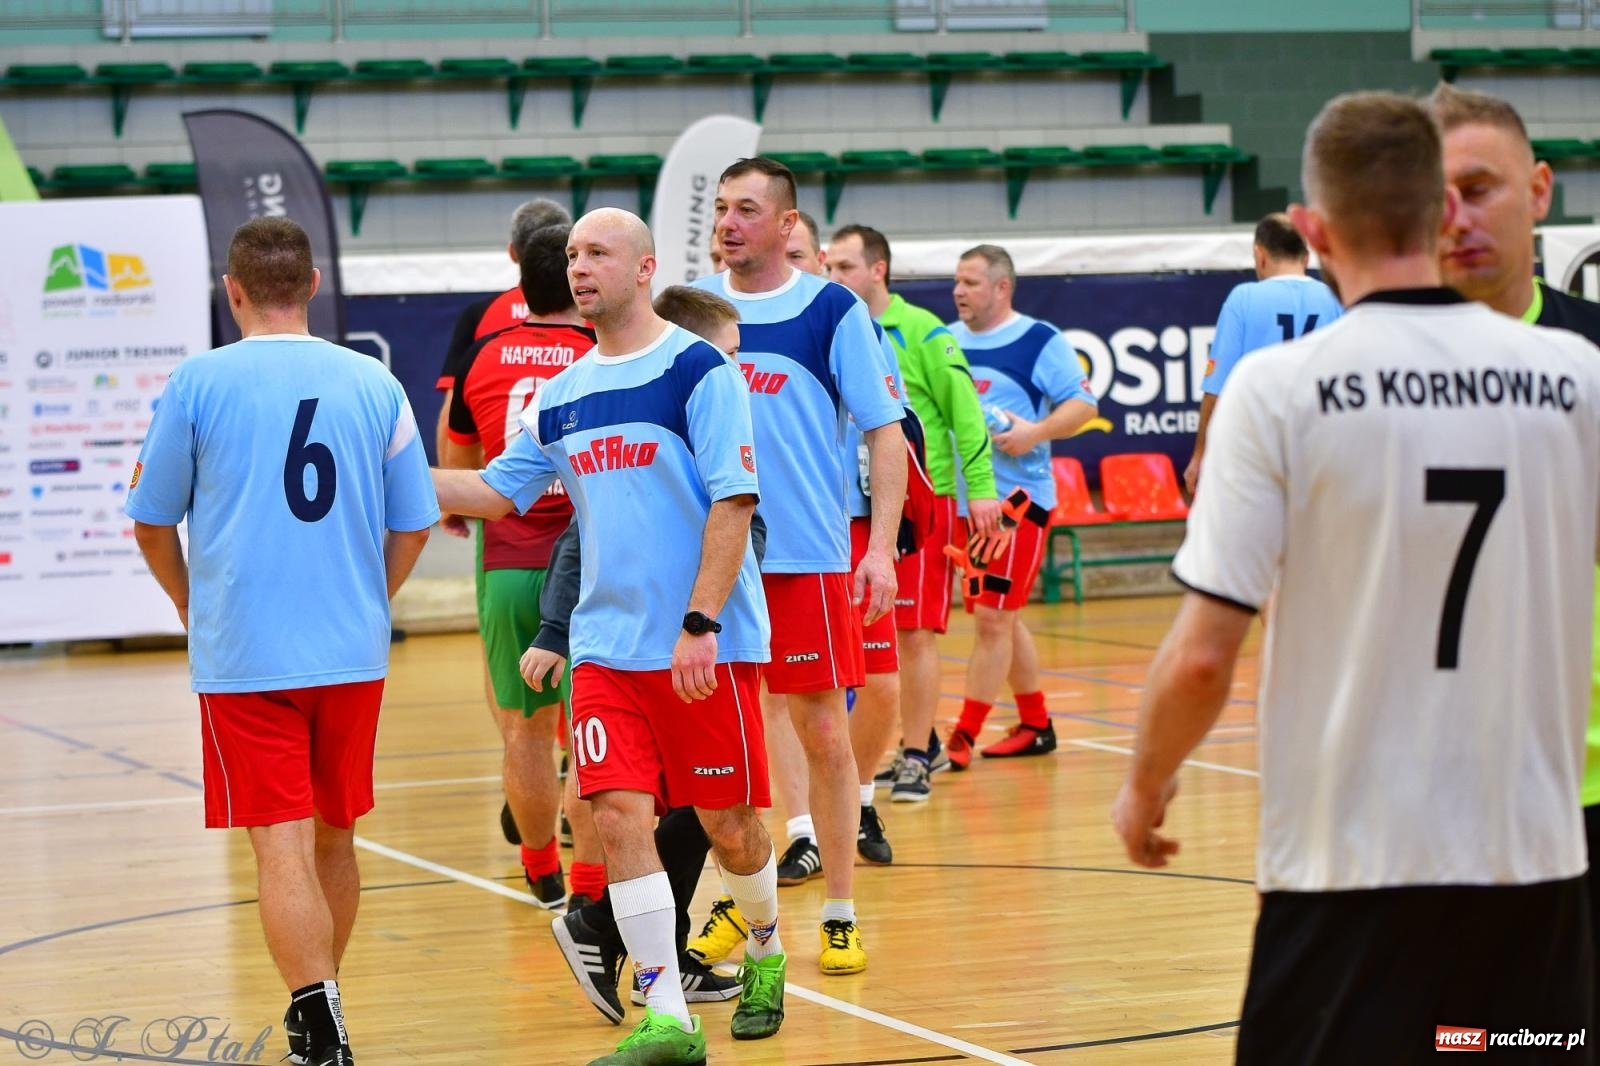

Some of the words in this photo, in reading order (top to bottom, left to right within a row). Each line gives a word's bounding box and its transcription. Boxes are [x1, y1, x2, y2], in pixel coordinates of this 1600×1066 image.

[500, 342, 575, 367] NAPRZÓD
[1317, 375, 1367, 414] KS
[1377, 367, 1577, 413] KORNOWAC
[283, 397, 337, 523] 6
[1424, 467, 1506, 670] 7
[574, 716, 608, 767] 10
